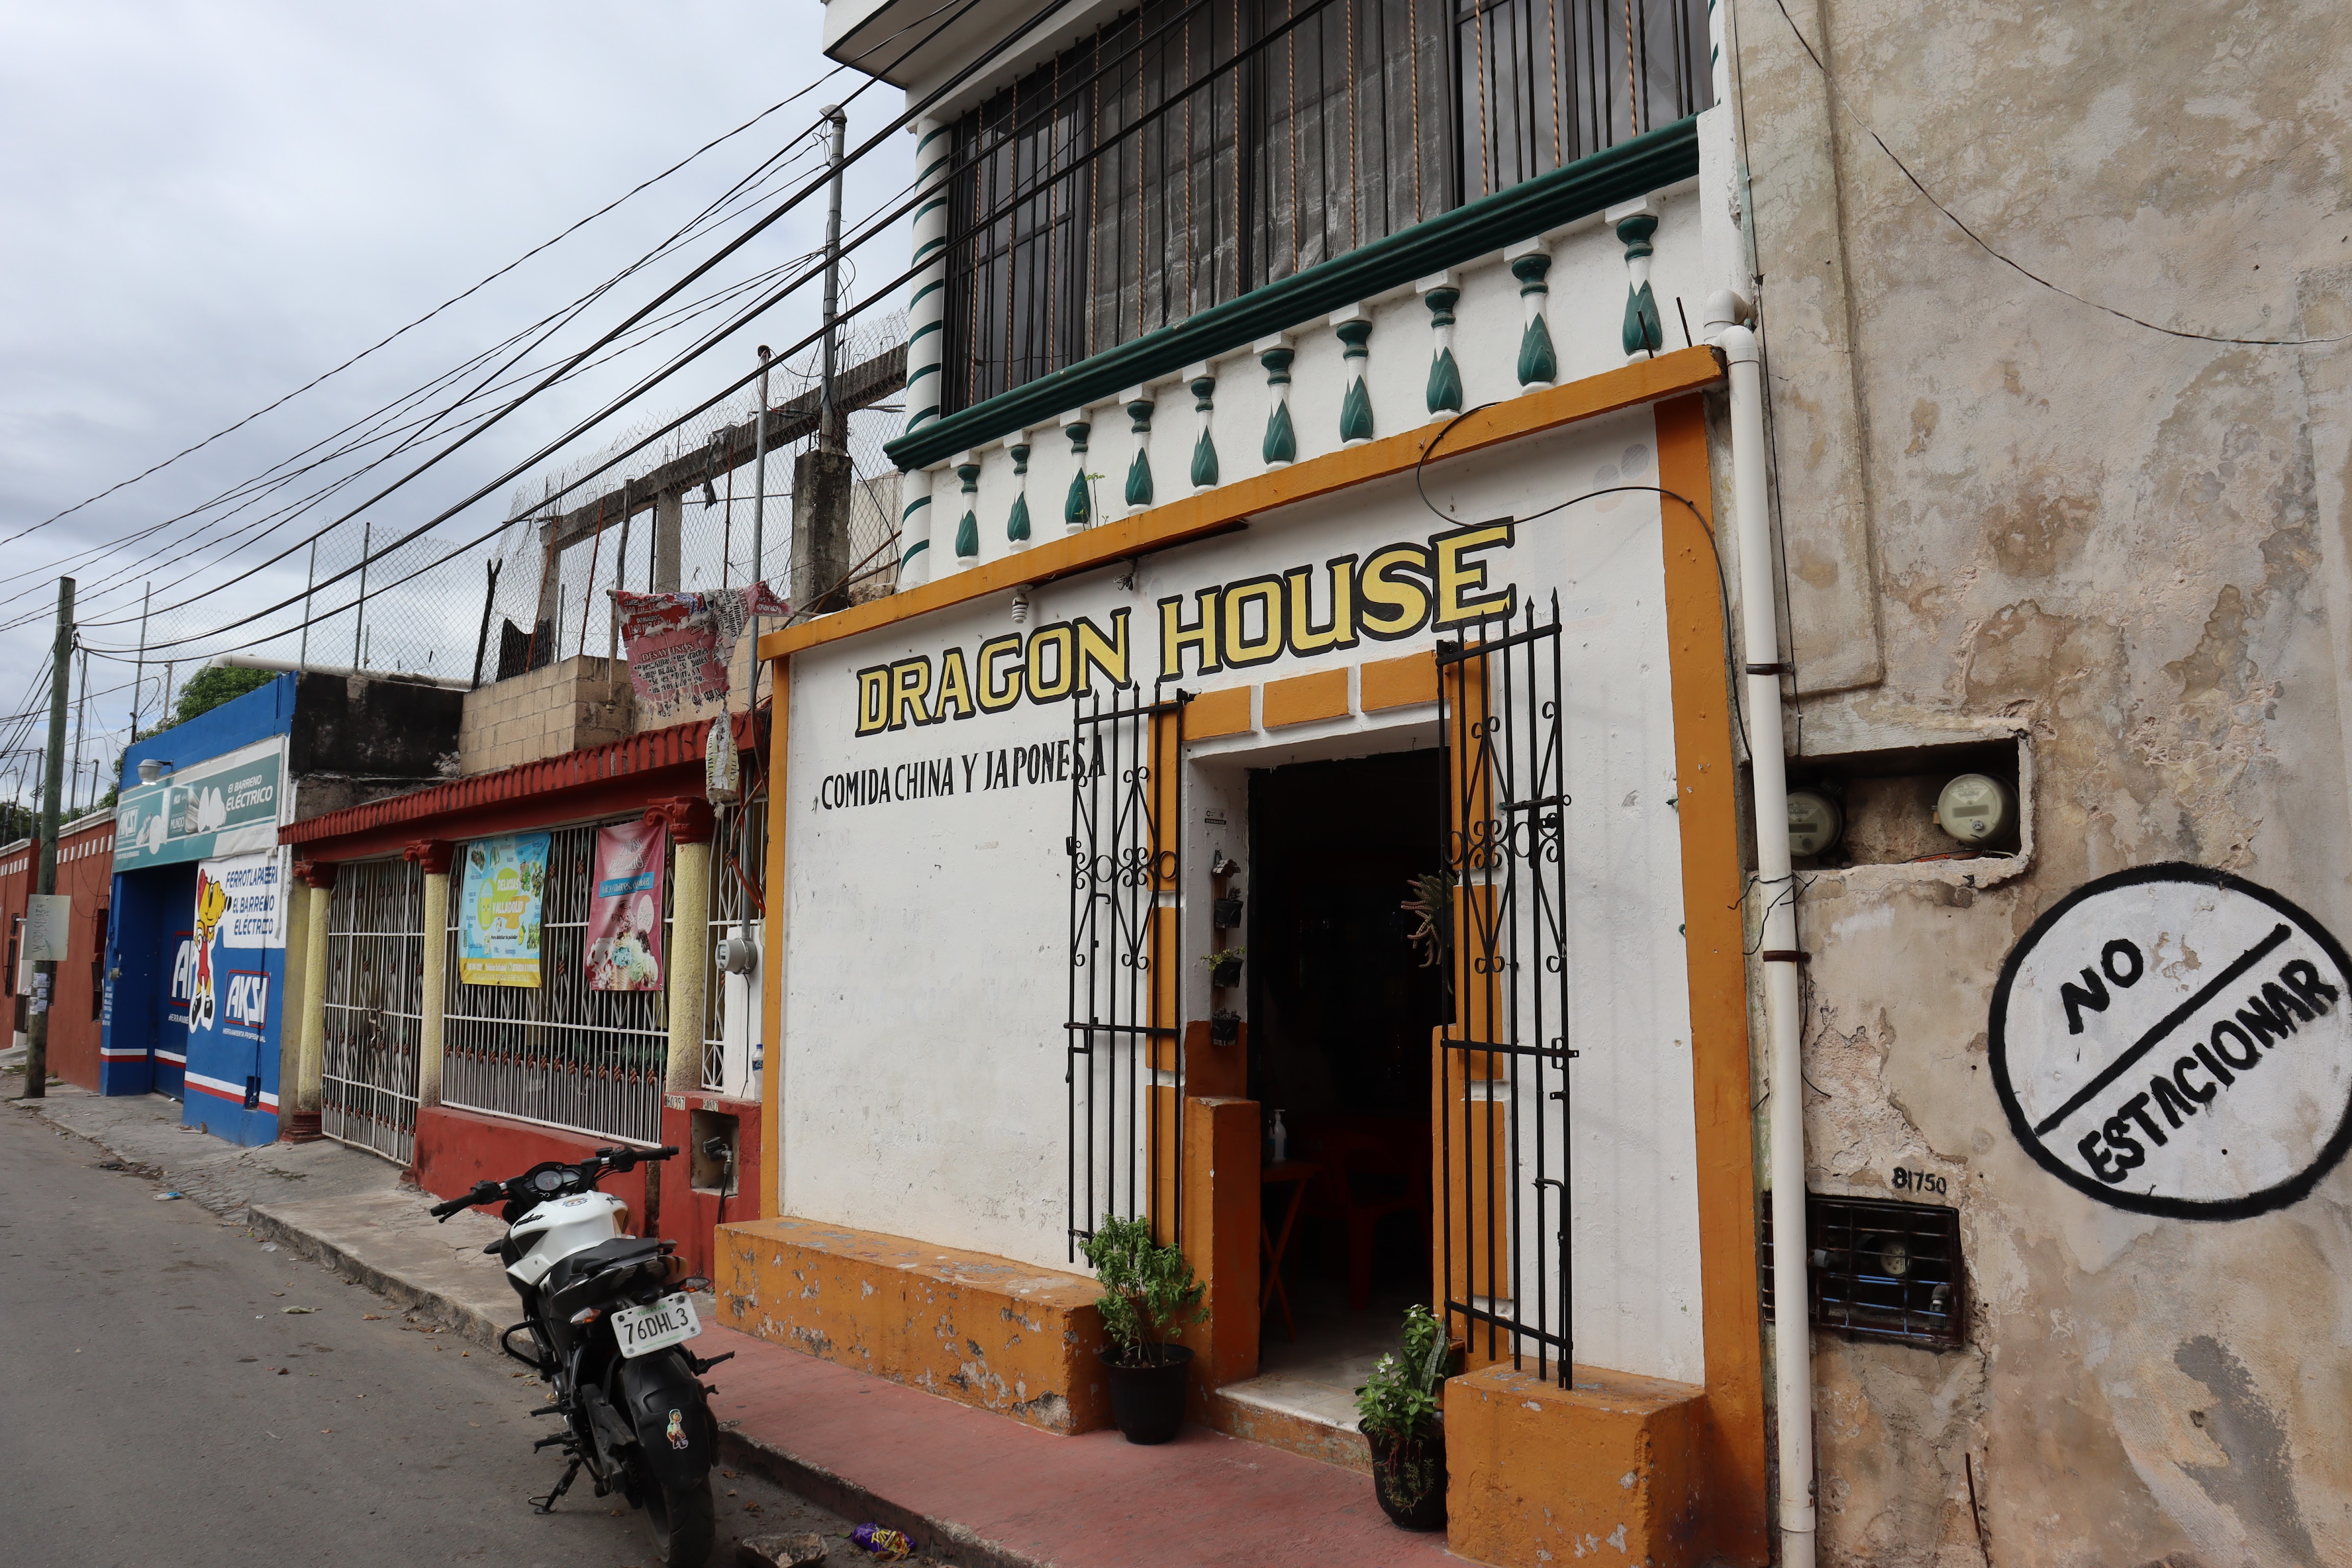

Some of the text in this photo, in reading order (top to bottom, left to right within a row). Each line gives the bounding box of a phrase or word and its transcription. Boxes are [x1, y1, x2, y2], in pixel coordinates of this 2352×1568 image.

[855, 515, 1517, 738] DRAGON HOUSE
[234, 774, 262, 791] BARRENO
[822, 735, 1107, 810] COMIDA CHINA Y JAPONESA
[226, 785, 273, 812] ELÉCTRICO
[118, 808, 139, 837] AKSI
[170, 817, 185, 830] MUNDO
[497, 878, 520, 891] DELICIAS
[233, 895, 275, 914] EL BARRENO
[492, 901, 523, 914] VALLADOLID
[225, 975, 268, 1027] AKSI
[2060, 938, 2144, 1035] NO
[2078, 958, 2340, 1184] ESTACIONAR
[1891, 1166, 1947, 1195] 81750
